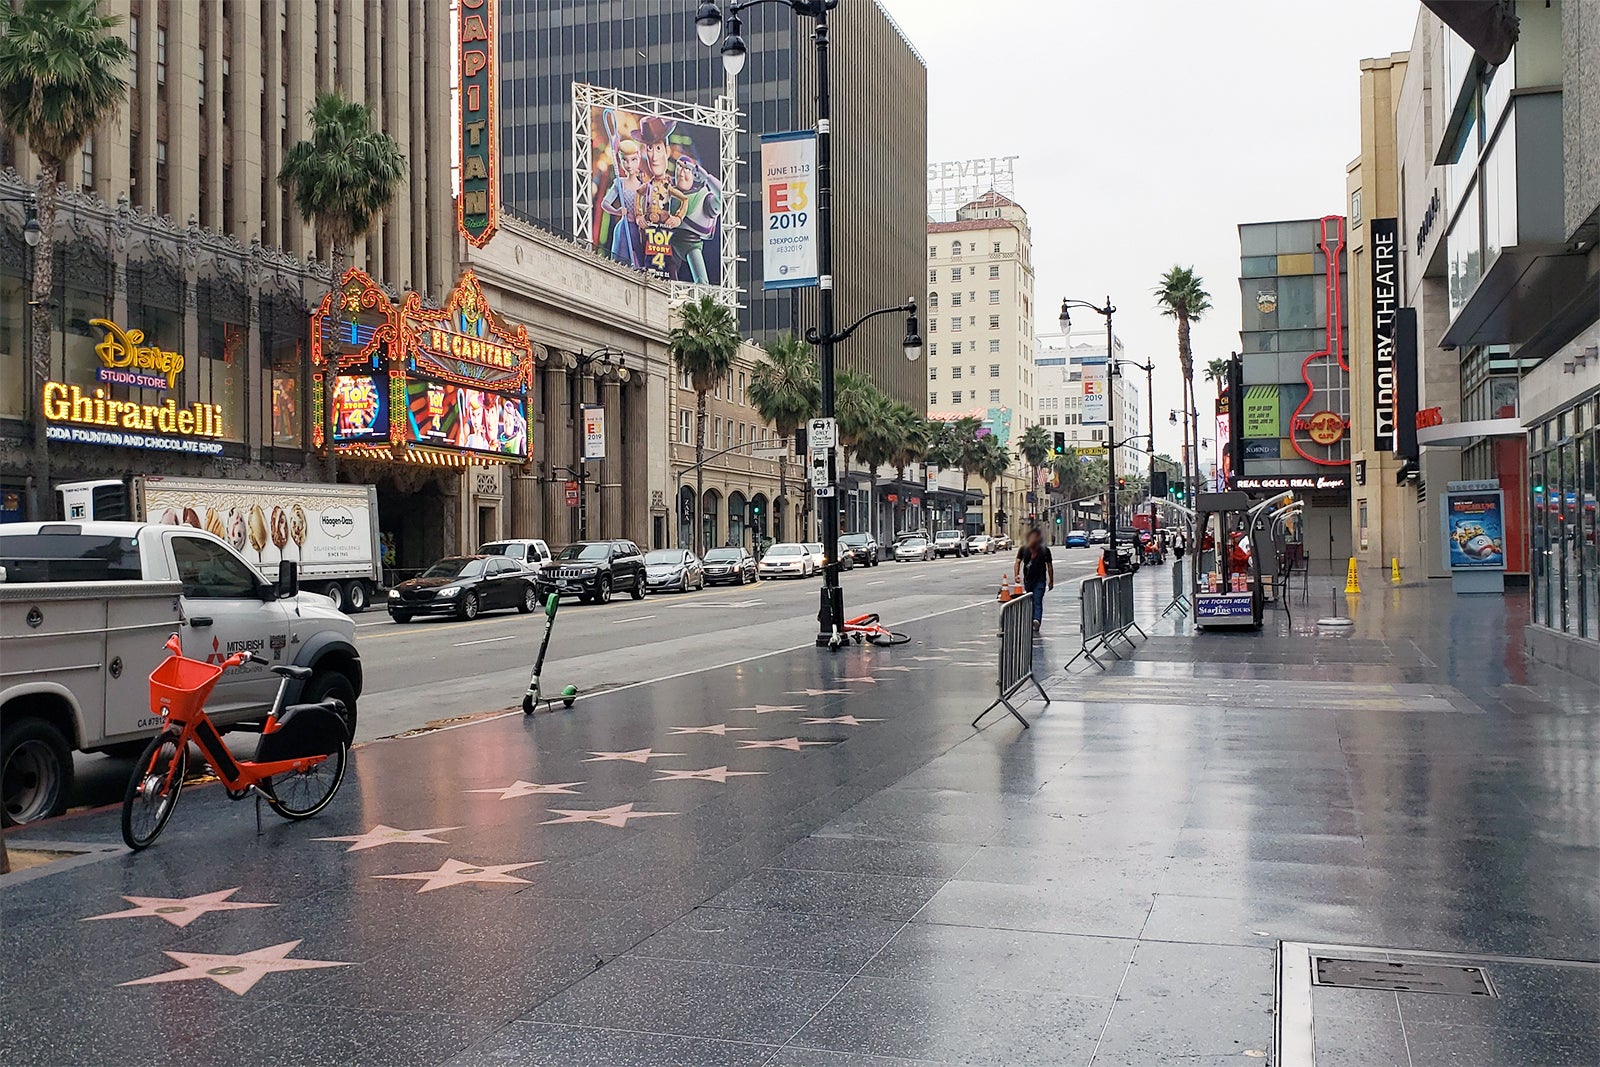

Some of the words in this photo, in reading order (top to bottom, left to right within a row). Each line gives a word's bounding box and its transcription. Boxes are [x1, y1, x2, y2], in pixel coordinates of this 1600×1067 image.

[462, 0, 488, 215] APITAN
[767, 167, 788, 176] JUNE
[790, 164, 810, 173] 11-13
[769, 181, 808, 214] E3
[769, 212, 808, 230] 2019
[645, 229, 674, 246] TOY
[769, 236, 809, 245] E3EXPO.COM
[648, 245, 670, 253] STORY
[652, 252, 665, 269] 4
[1376, 232, 1395, 329] THEATRE
[432, 329, 450, 352] EL
[452, 335, 513, 368] CAPITAN
[100, 369, 136, 384] STUDIO
[137, 376, 167, 389] STORE
[341, 385, 372, 402] TOY
[1084, 382, 1103, 395] E3
[427, 390, 445, 408] TOY
[1084, 394, 1103, 402] 2019
[43, 380, 224, 437] Ghirardelli
[349, 408, 363, 426] 4
[432, 414, 441, 430] 4
[587, 423, 602, 434] E3
[1295, 417, 1326, 431] Hard
[73, 429, 122, 444] FOUNTAIN
[123, 434, 144, 447] AND
[144, 437, 199, 452] CHOCOLATE
[199, 442, 223, 453] SHOP
[1237, 479, 1260, 488] REAL
[1261, 479, 1289, 488] GOLD.
[1290, 478, 1314, 487] REAL
[226, 639, 265, 652] MITSUBISHI
[137, 719, 148, 728] CA
